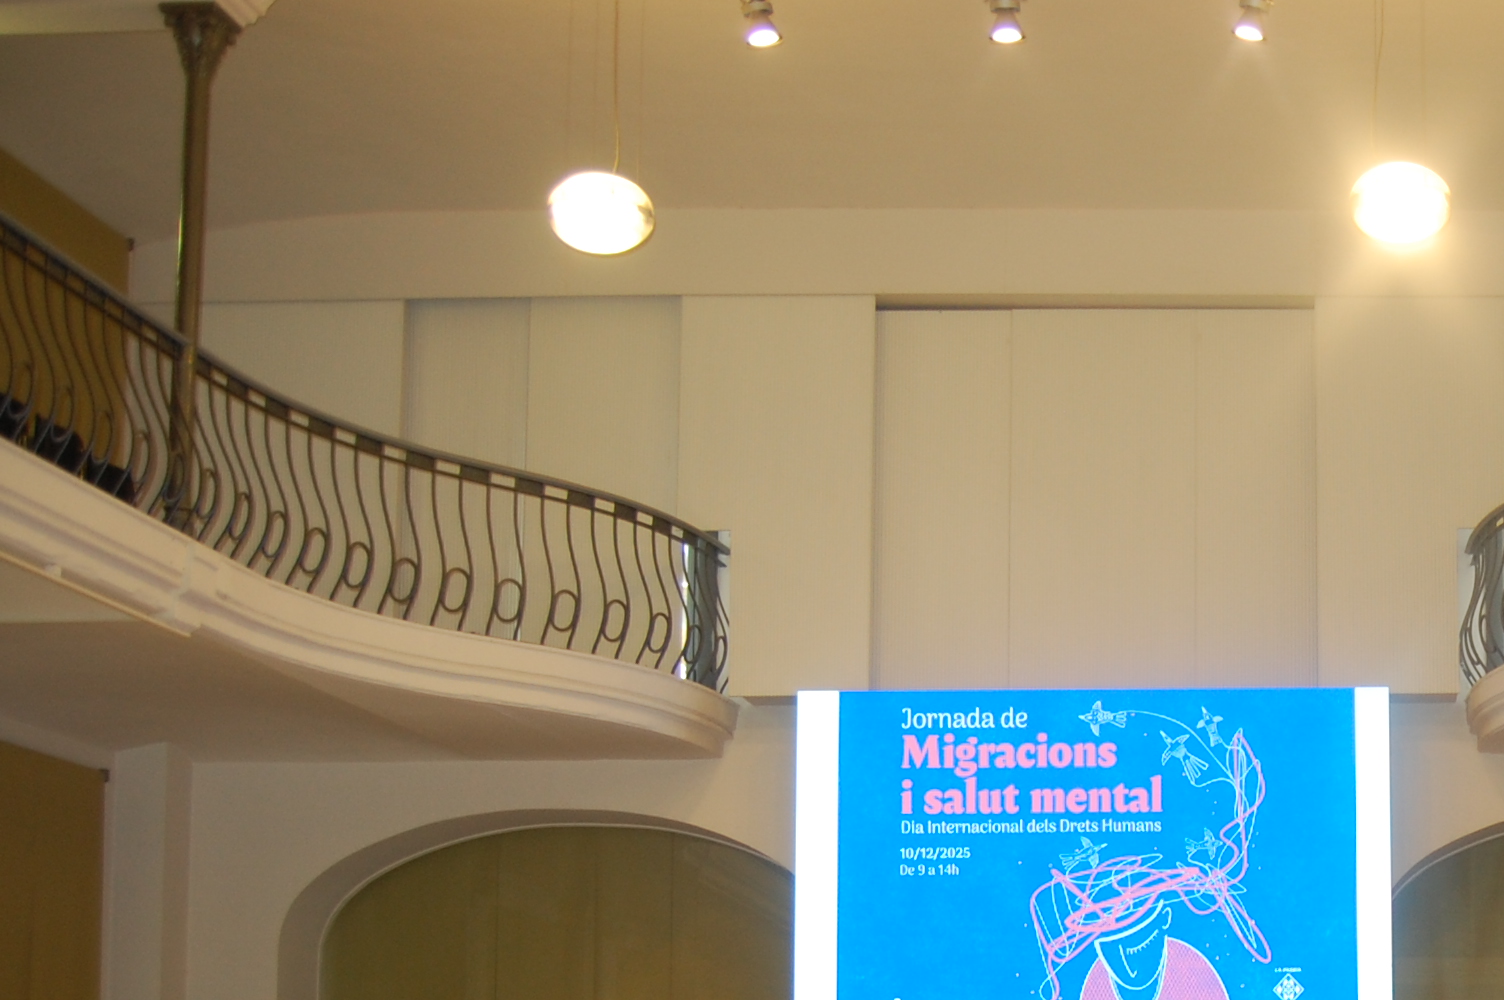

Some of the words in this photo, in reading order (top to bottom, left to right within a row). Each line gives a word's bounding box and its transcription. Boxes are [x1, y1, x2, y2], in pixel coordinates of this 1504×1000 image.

[901, 707, 995, 729] Jornada
[1000, 707, 1028, 729] de
[901, 732, 1117, 777] Migracions
[900, 779, 913, 814] i
[923, 776, 1019, 814] salut
[1030, 774, 1163, 813] mental
[901, 820, 924, 834] Dia
[928, 819, 1023, 834] Internacional
[1027, 819, 1056, 833] dels
[1060, 819, 1098, 833] Drets
[1102, 818, 1162, 833] Humans
[900, 847, 971, 861] 10/12/2025
[900, 864, 915, 876] De
[917, 864, 925, 876] 9
[928, 866, 936, 876] a
[938, 863, 959, 876] 14h
